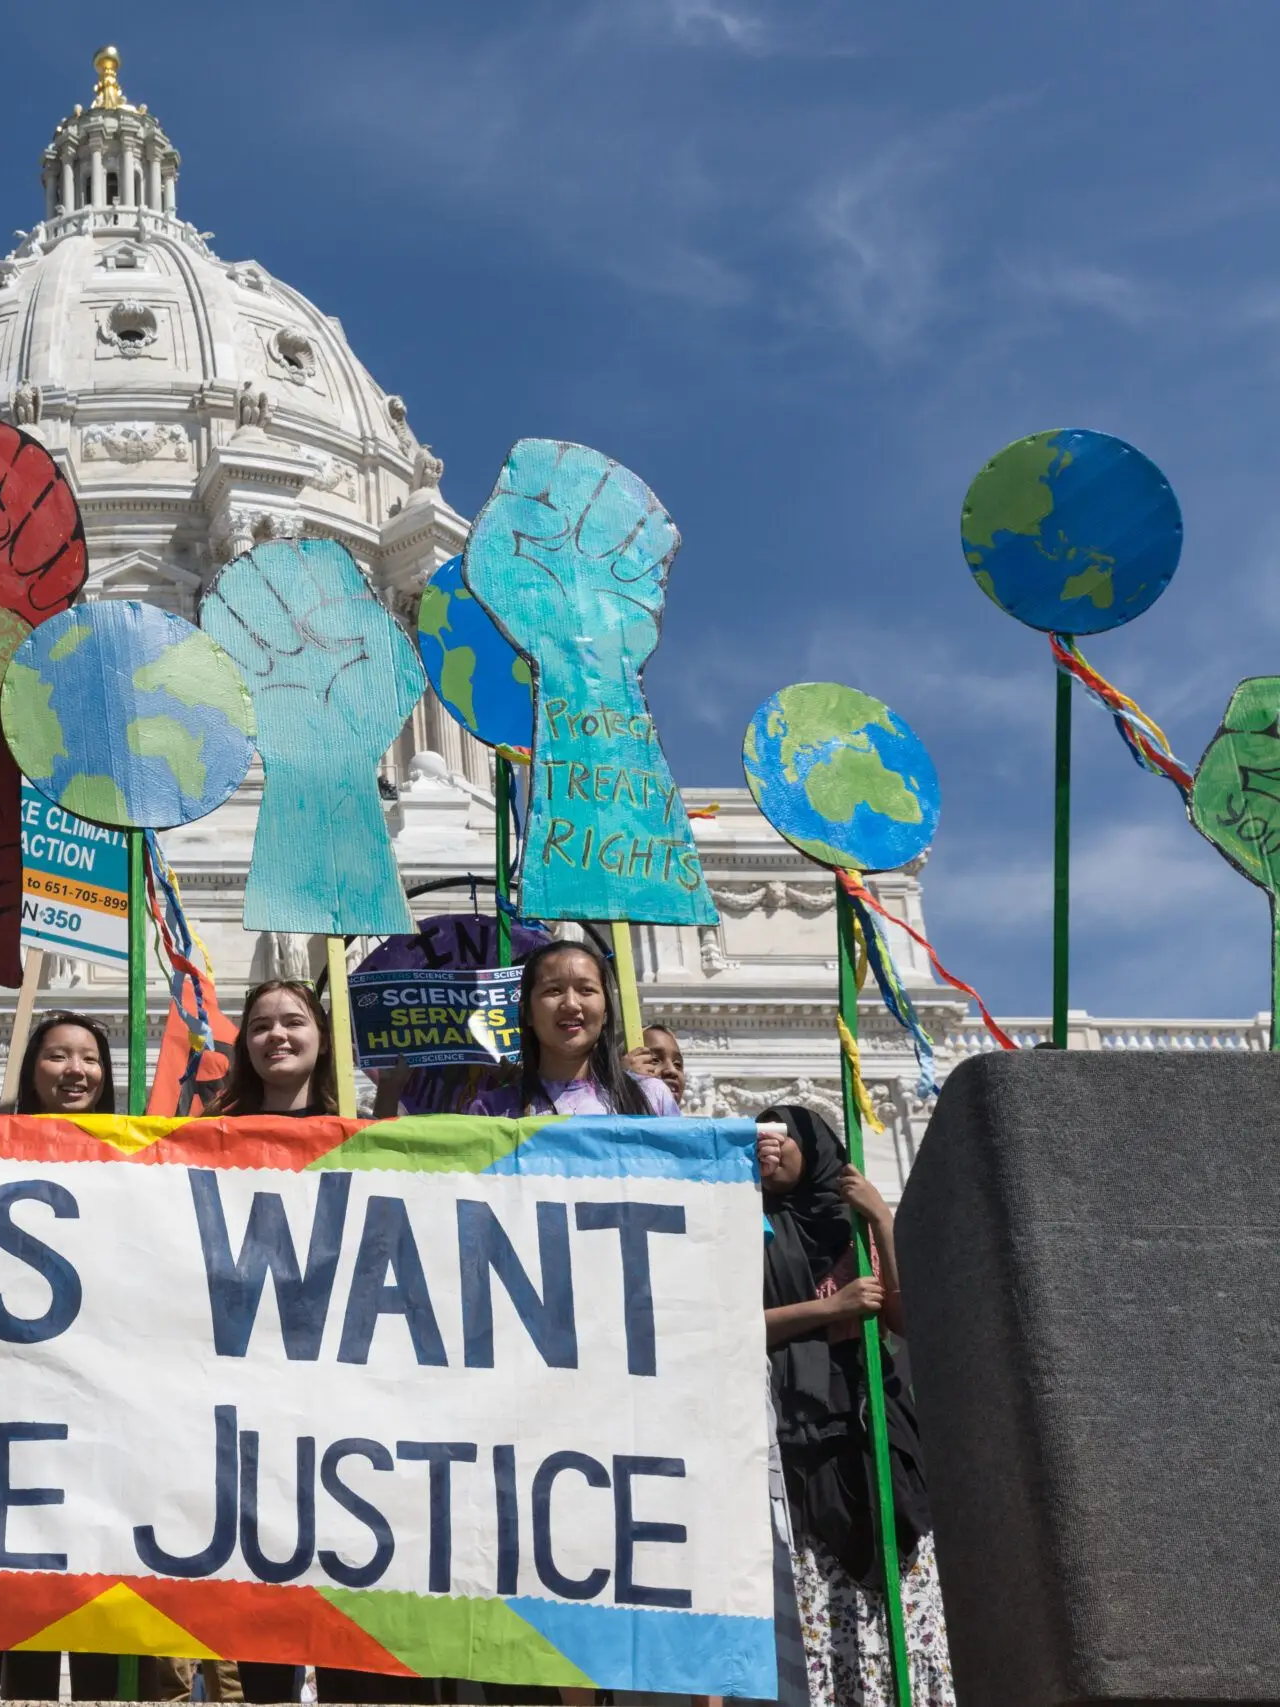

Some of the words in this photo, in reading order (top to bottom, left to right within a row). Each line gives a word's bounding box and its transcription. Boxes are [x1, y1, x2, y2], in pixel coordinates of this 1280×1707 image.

[540, 760, 678, 823] TREATY
[46, 806, 128, 849] CLIMAT
[21, 830, 95, 871] ACTION
[542, 818, 700, 891] RIGHTS
[27, 877, 40, 889] to
[382, 987, 508, 1007] SCIENCE
[413, 972, 455, 980] SCIENCE
[391, 1007, 507, 1026] SERVES
[187, 1167, 686, 1377] WANT
[132, 1404, 692, 1608] JUSTICE
